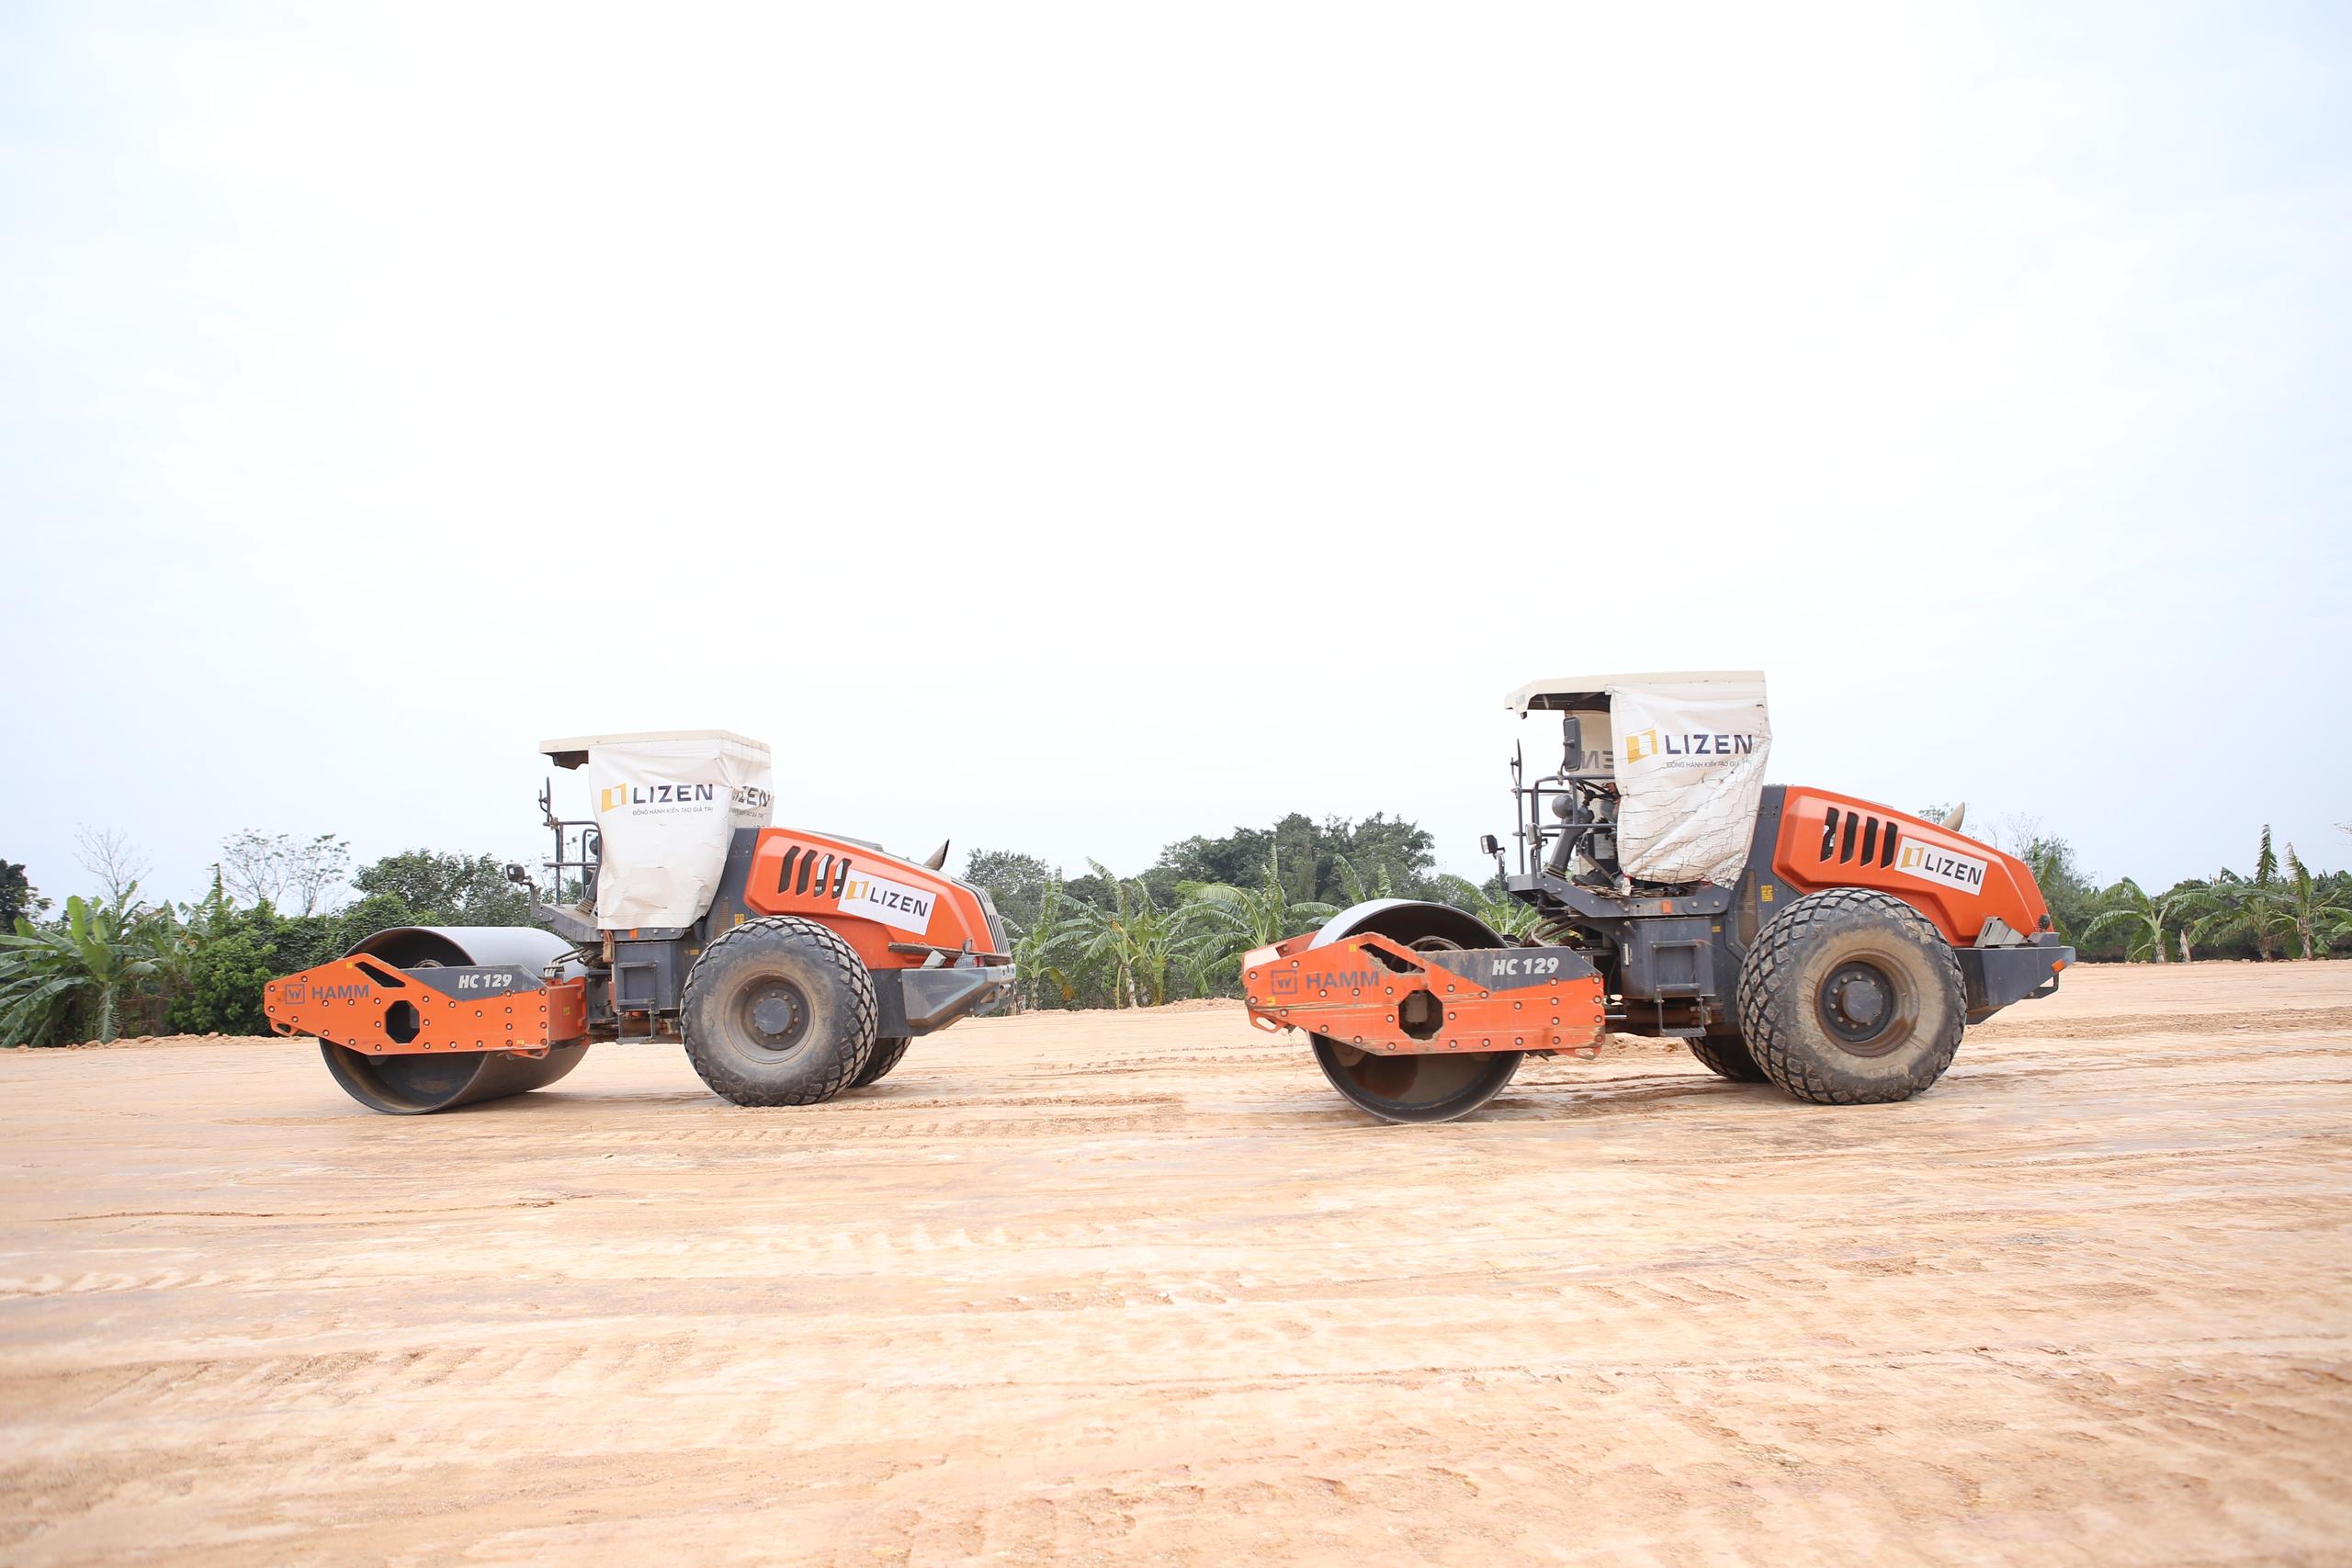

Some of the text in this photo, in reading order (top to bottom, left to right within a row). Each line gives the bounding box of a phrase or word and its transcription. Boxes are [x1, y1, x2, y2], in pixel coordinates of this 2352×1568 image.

[1665, 734, 1752, 754] LIZEN
[633, 784, 713, 805] LIZEN
[1924, 853, 1982, 886] LIZEN
[869, 886, 928, 917] LIZEN
[1492, 957, 1559, 976] HC 129
[458, 974, 513, 989] HC 129
[1306, 970, 1380, 989] HAMM
[311, 984, 369, 1000] HAMM
